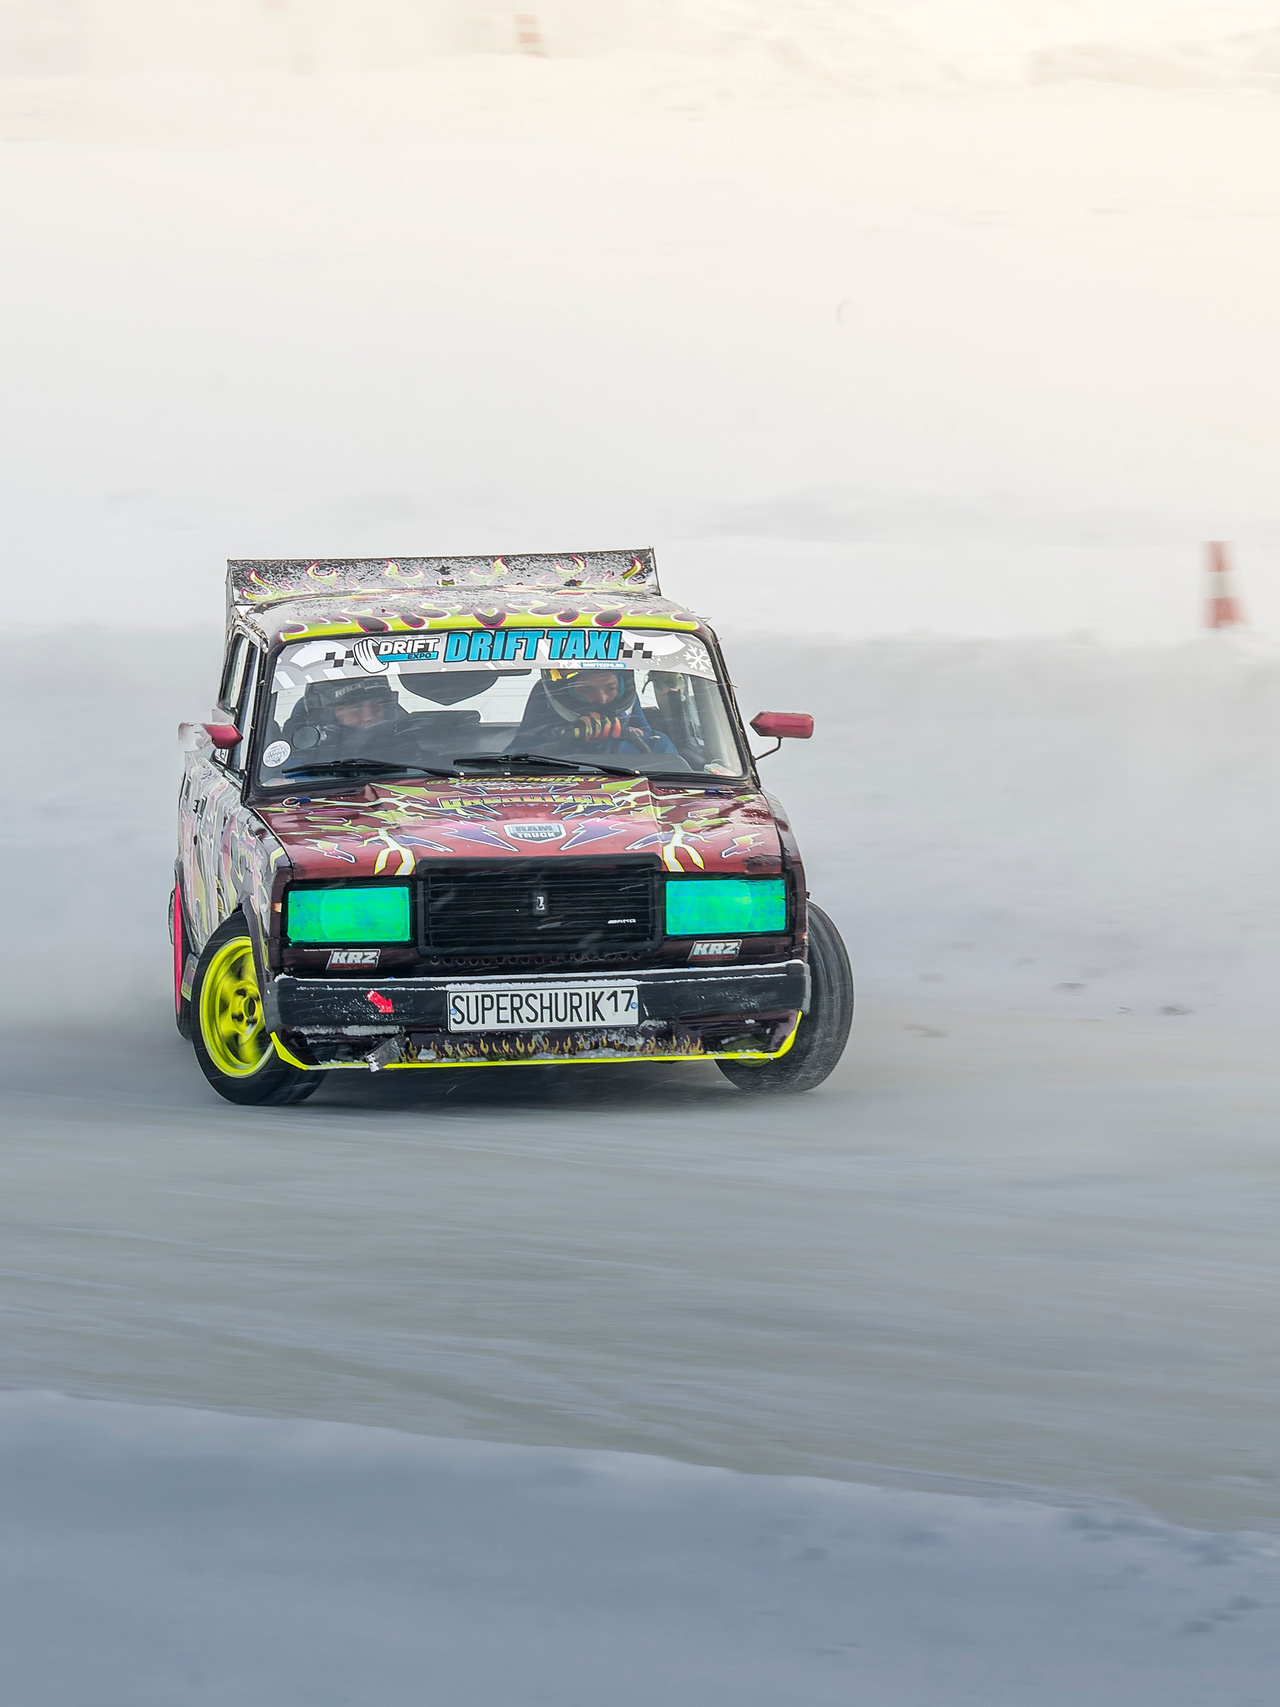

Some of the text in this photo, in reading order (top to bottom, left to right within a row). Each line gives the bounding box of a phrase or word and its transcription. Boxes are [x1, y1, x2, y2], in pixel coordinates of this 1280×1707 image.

[379, 639, 440, 655] DRIFT
[443, 629, 622, 662] DRIFT TAXI
[407, 652, 432, 660] EXPO
[692, 942, 739, 956] KRZ
[330, 951, 378, 965] KRZ
